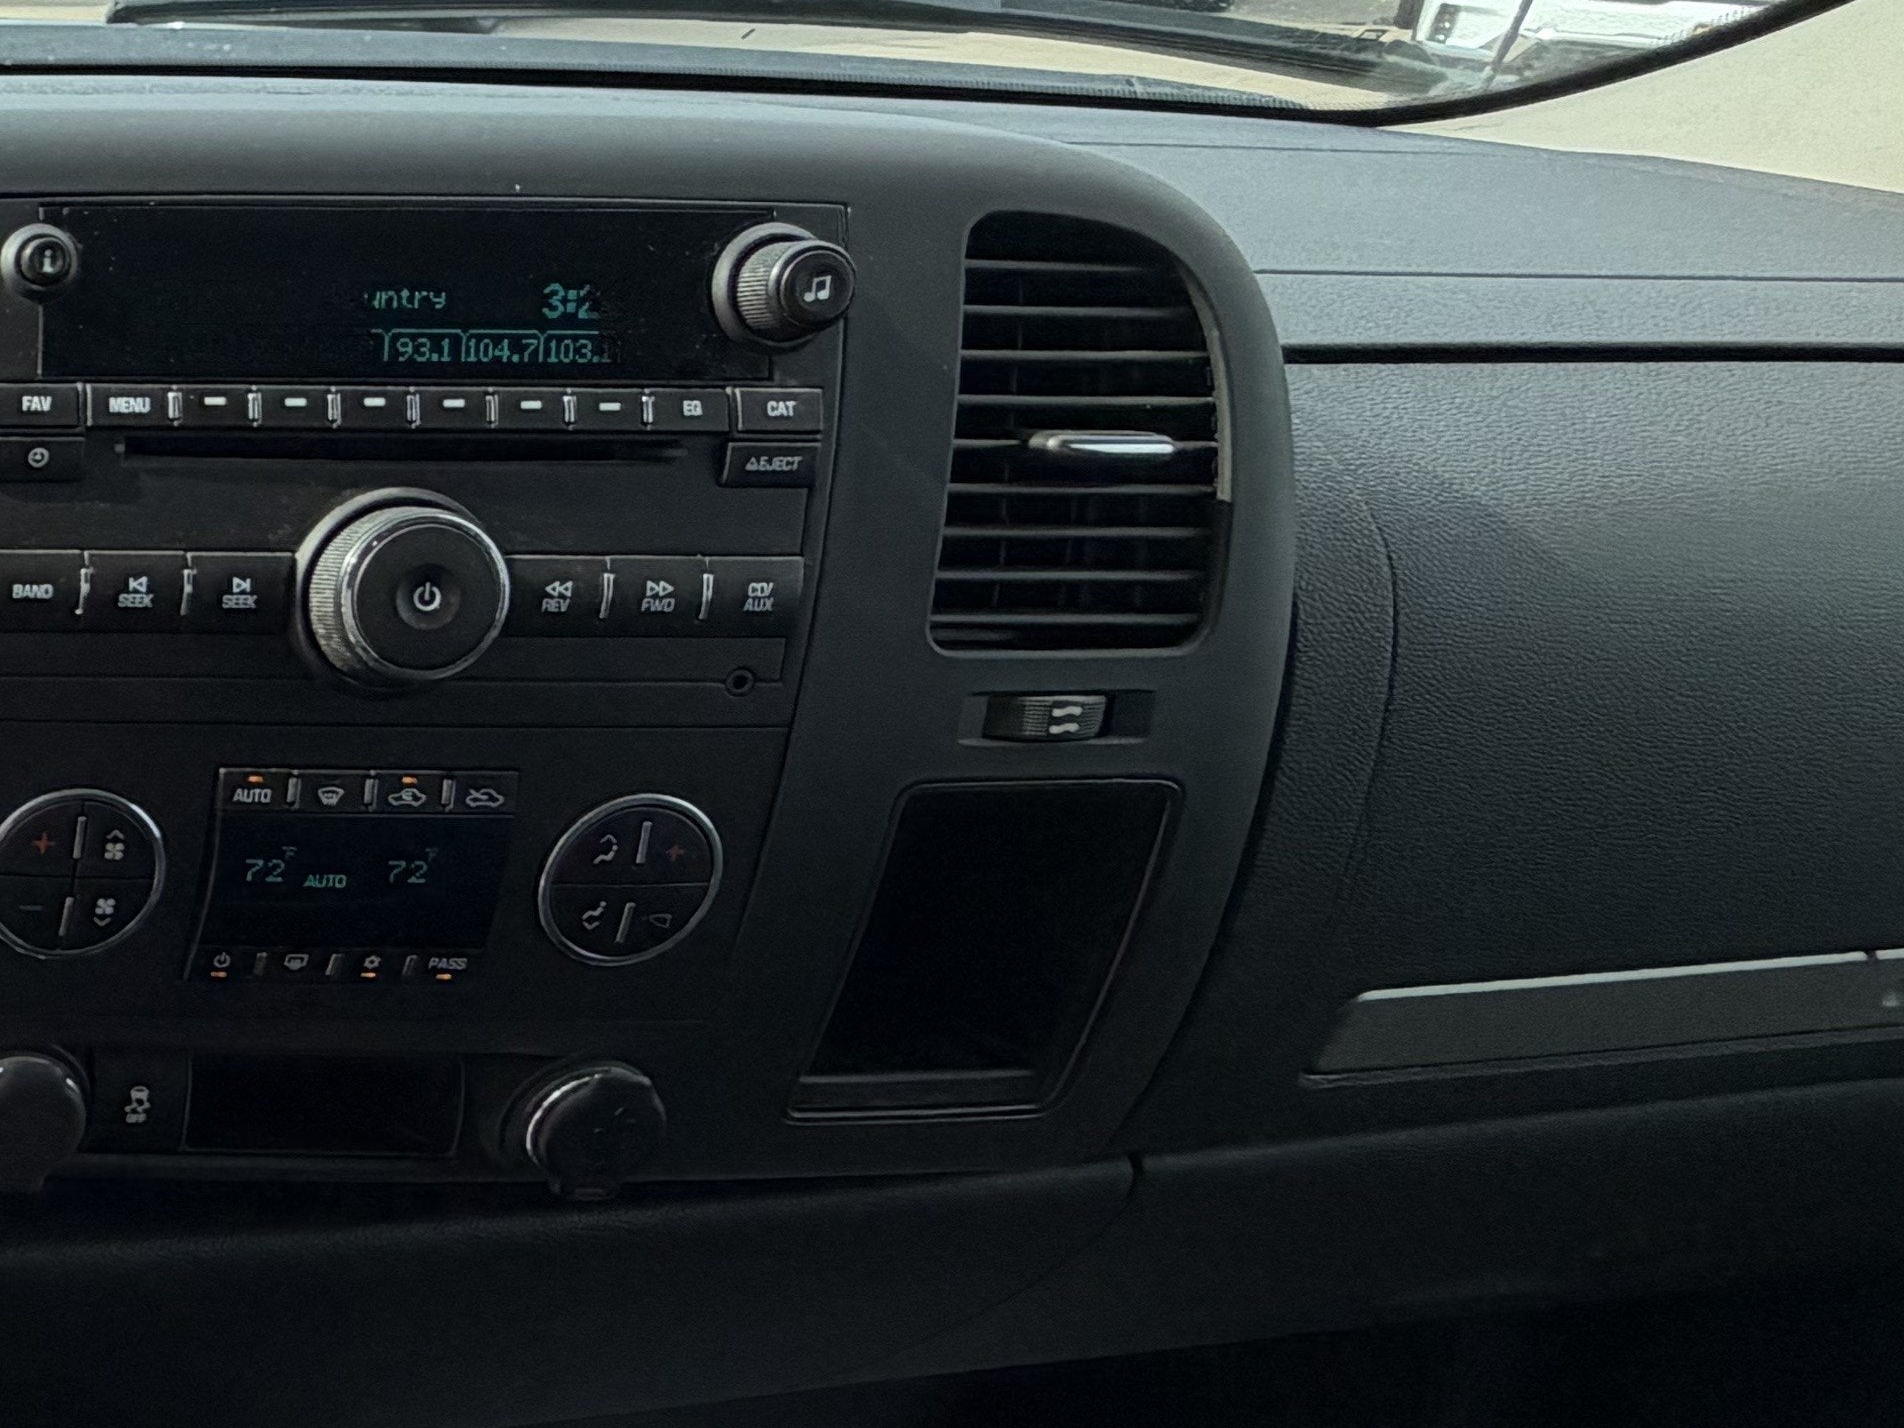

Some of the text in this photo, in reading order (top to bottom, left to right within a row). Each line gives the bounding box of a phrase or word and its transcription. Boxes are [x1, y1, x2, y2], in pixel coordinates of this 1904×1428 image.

[395, 337, 453, 363] 93.1
[467, 338, 539, 363] 104.7
[21, 394, 53, 413] FAV
[108, 395, 152, 414] MENU
[682, 399, 702, 417] EQ
[766, 399, 796, 417] CAT
[757, 456, 803, 472] EJECT
[11, 583, 54, 599] BAND
[118, 592, 154, 608] SEEK
[221, 593, 258, 609] SEEK
[541, 598, 571, 613] REV
[641, 597, 676, 613] FWD
[743, 596, 775, 613] AUX
[232, 787, 273, 804] AUTO
[245, 858, 287, 883] 72
[302, 874, 347, 889] AUTO
[387, 859, 429, 885] 72
[427, 957, 468, 971] PASS
